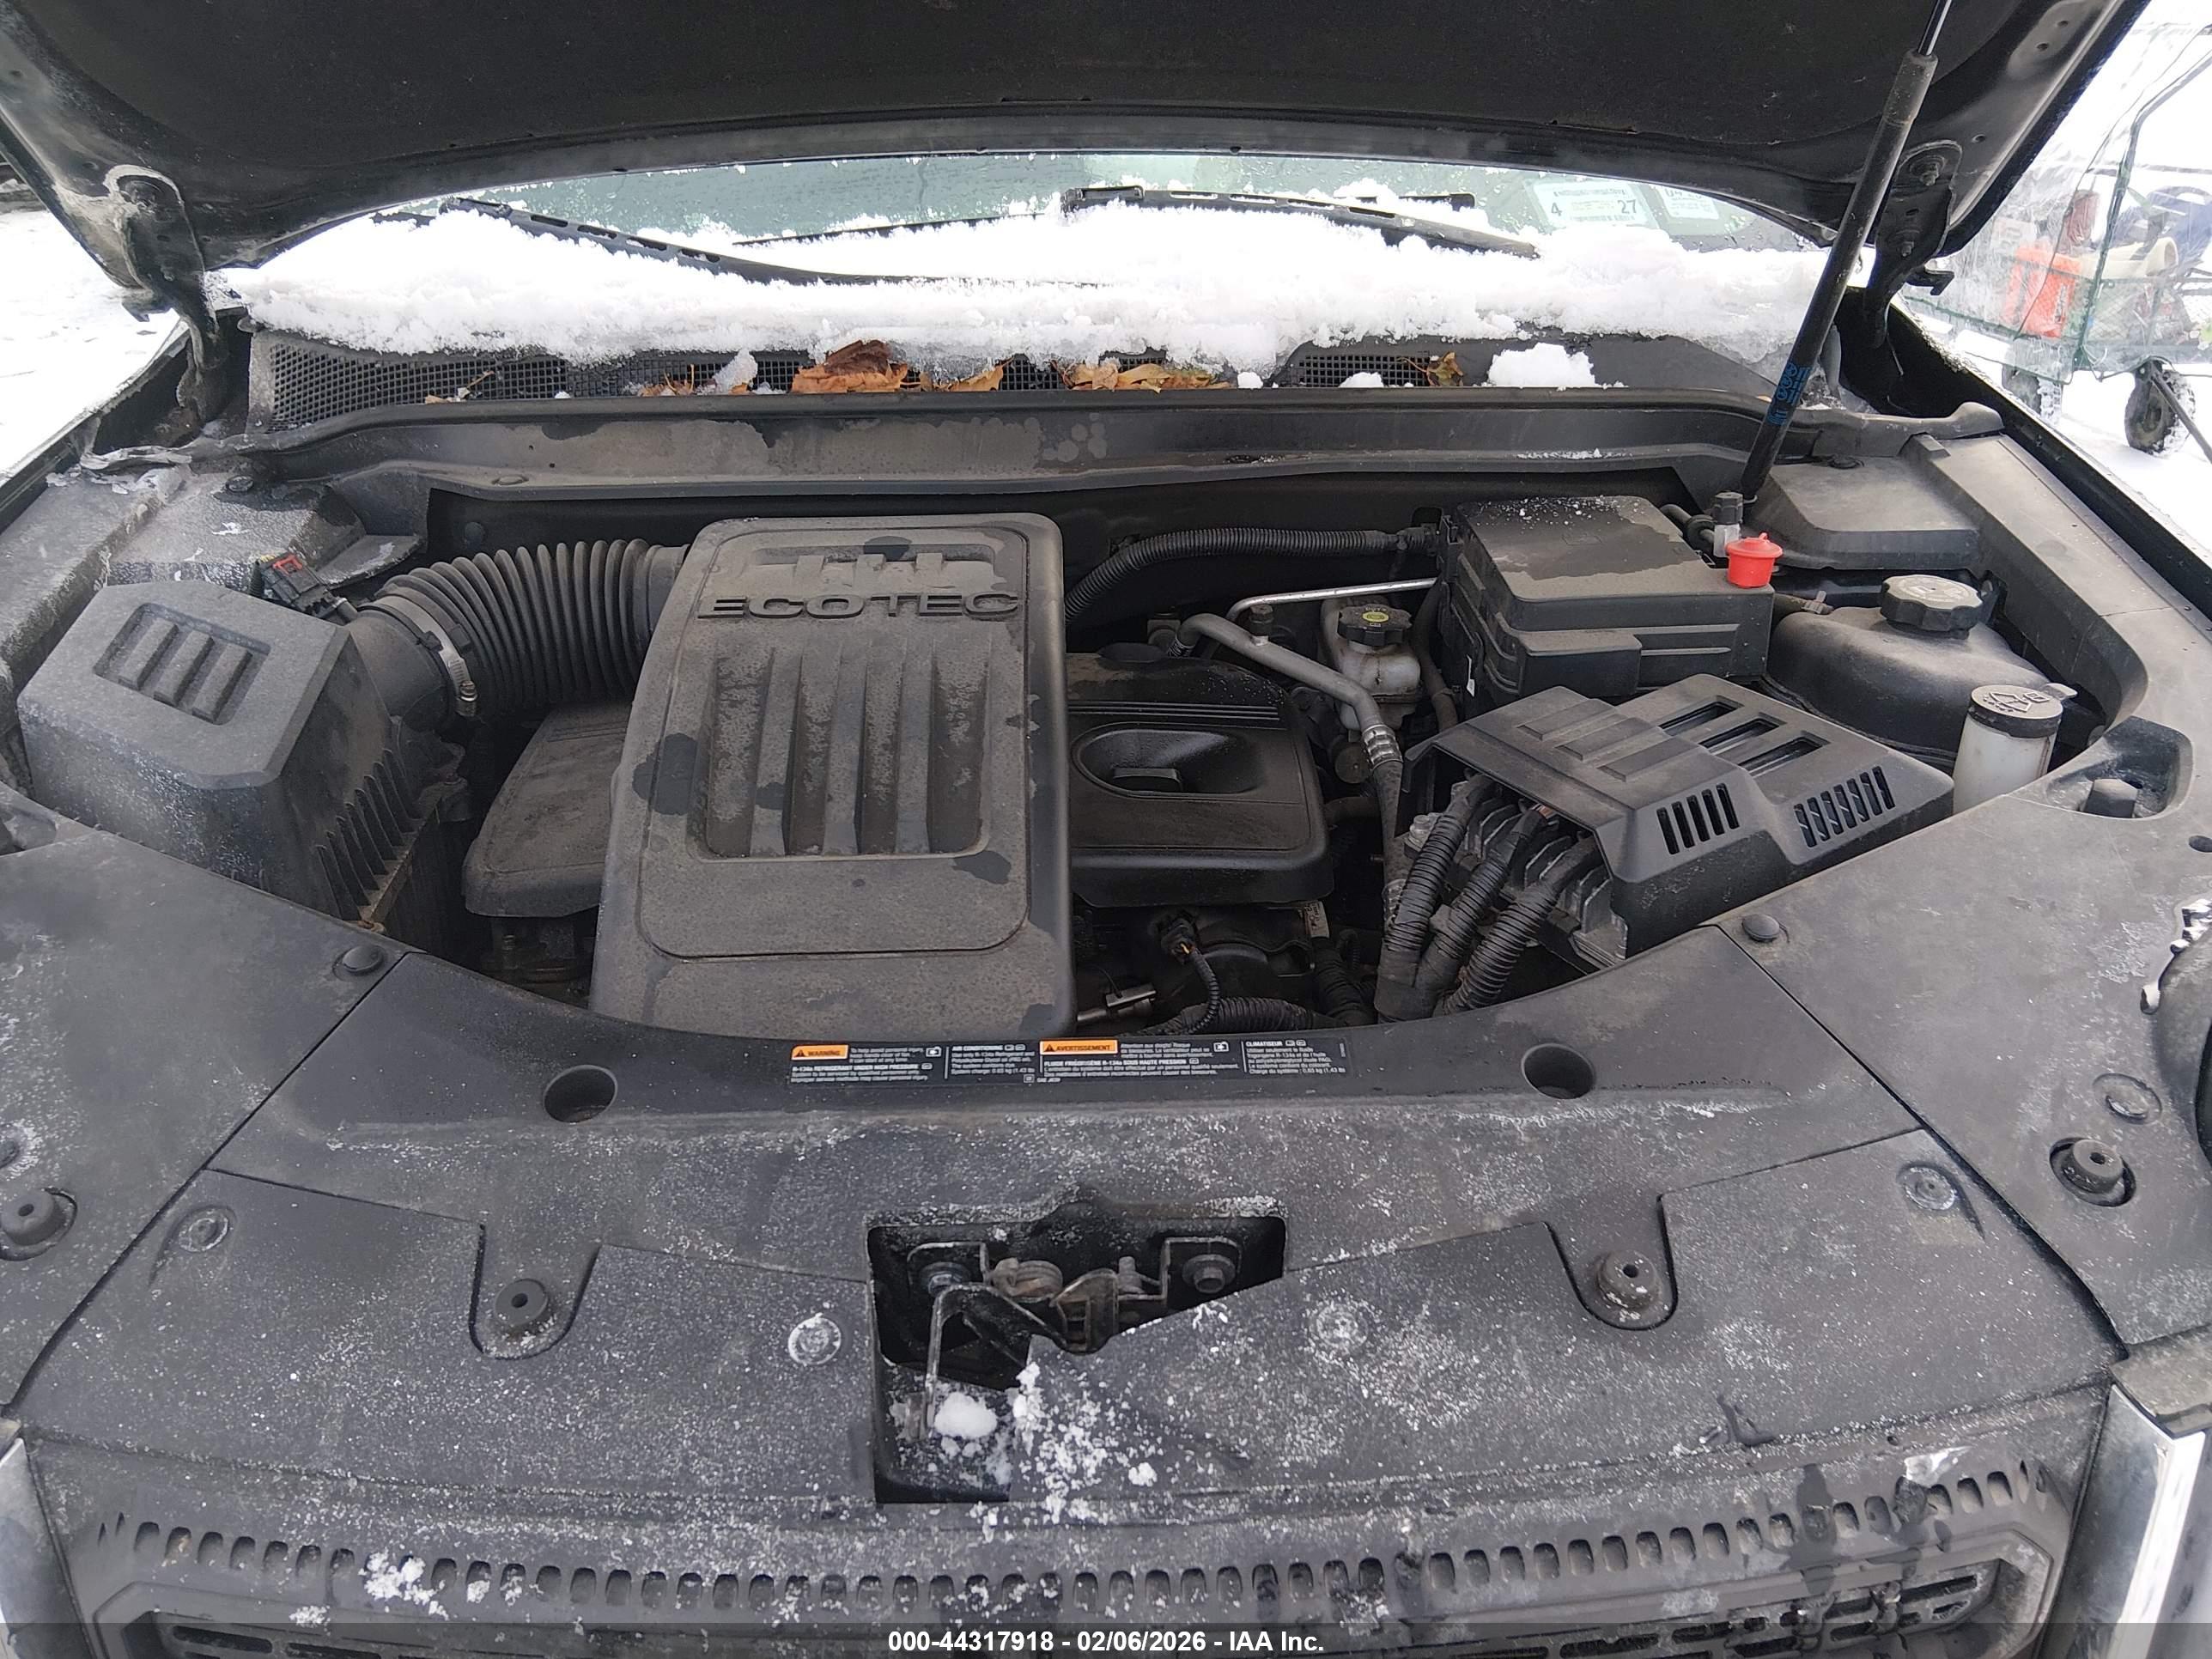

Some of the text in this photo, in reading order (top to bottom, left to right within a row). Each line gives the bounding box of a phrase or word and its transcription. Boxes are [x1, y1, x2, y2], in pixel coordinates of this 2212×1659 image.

[1551, 202, 1563, 216] 4
[1617, 198, 1637, 215] 27
[697, 592, 1018, 620] ECOTEC
